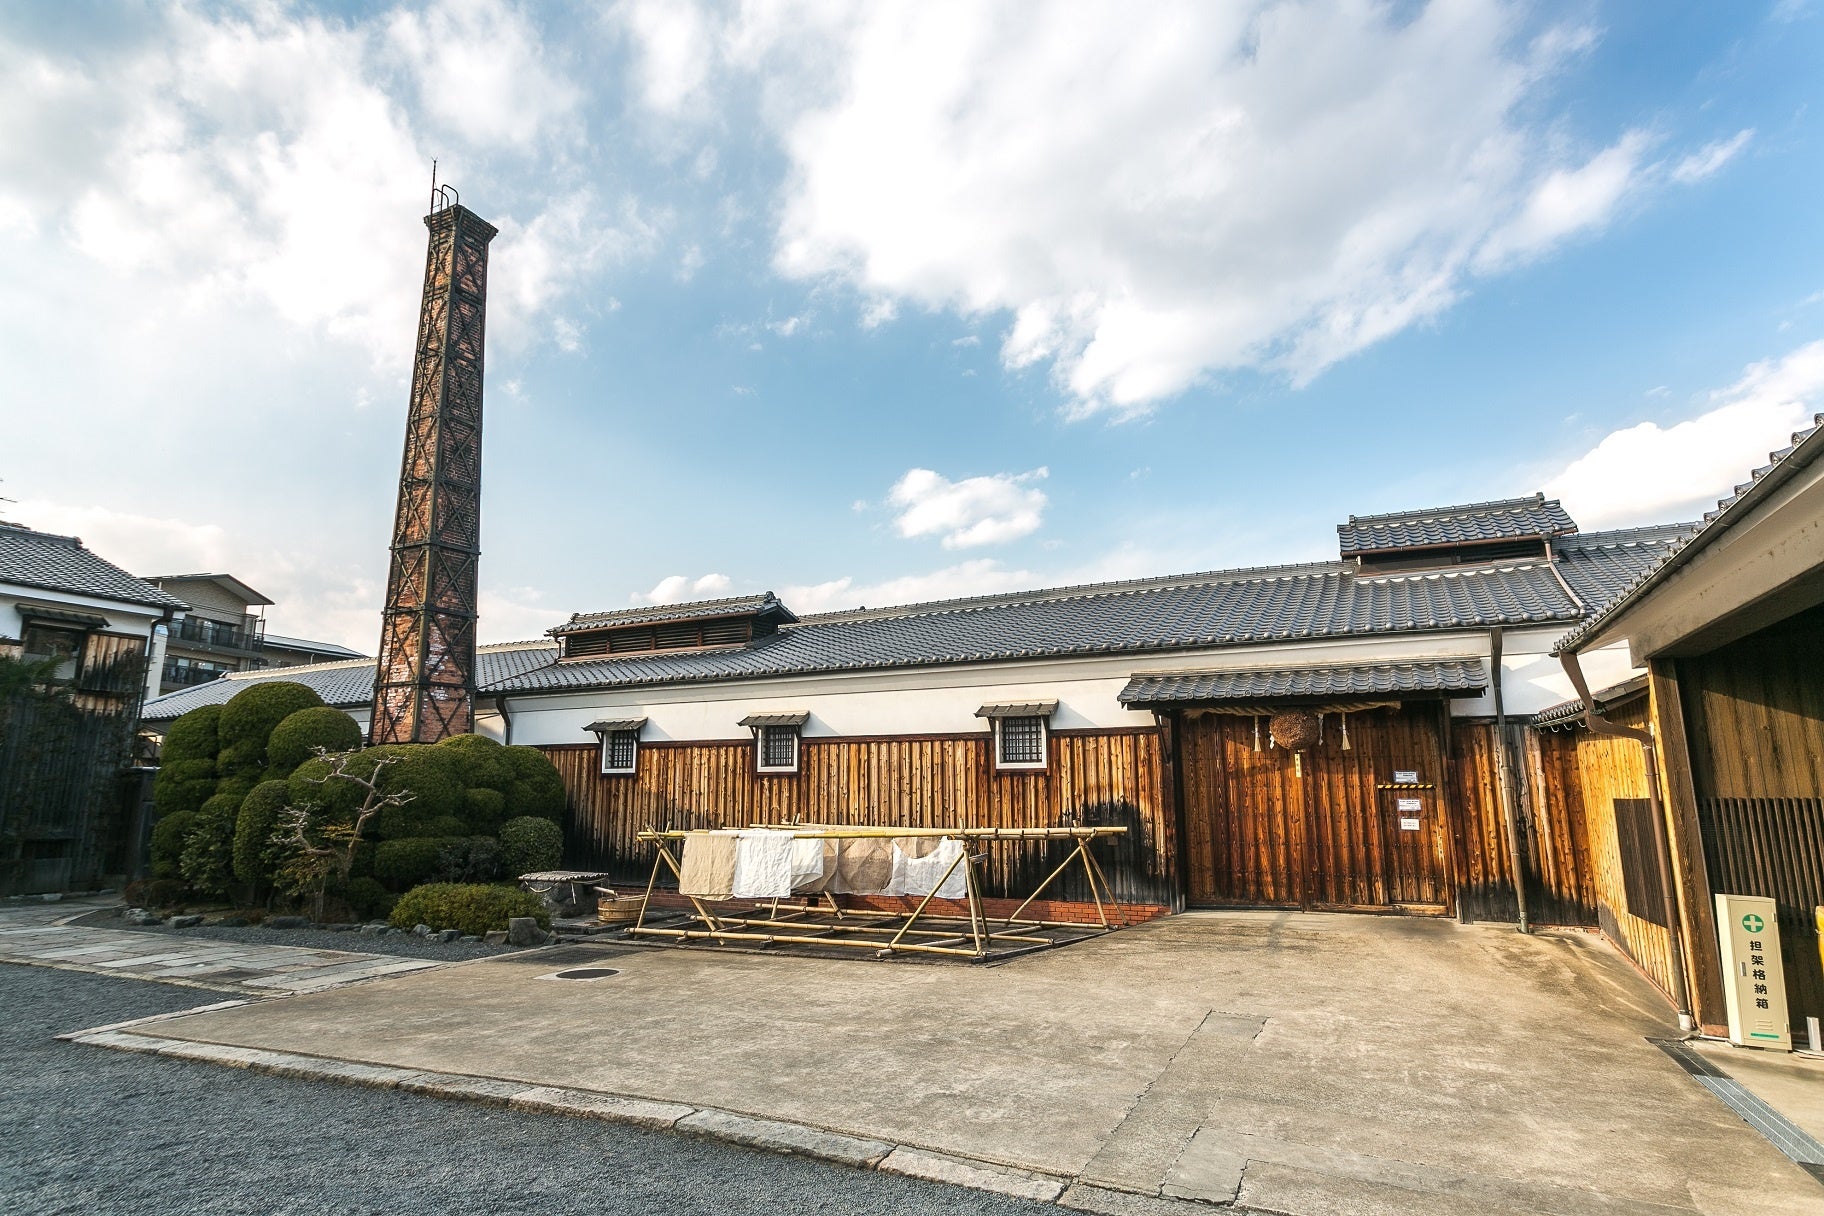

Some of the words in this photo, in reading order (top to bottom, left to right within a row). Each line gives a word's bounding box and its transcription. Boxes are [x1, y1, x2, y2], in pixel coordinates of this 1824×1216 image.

[1749, 940, 1769, 1009] 担架格納箱
